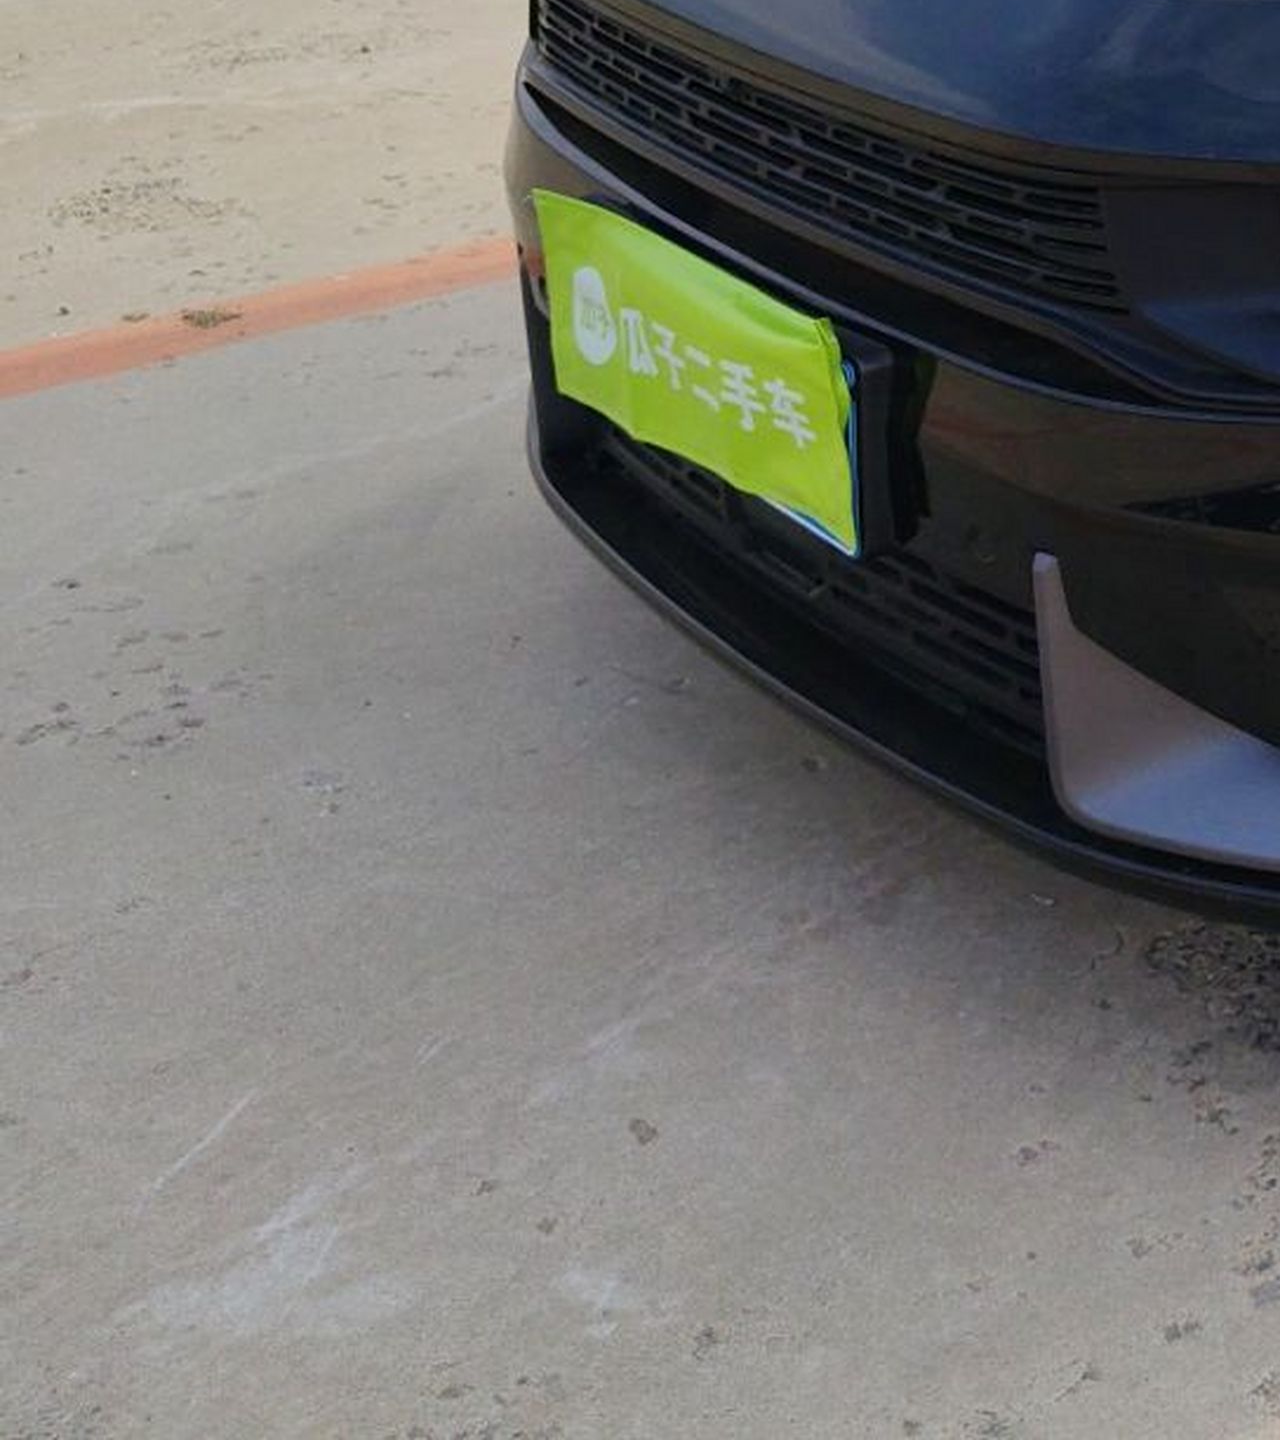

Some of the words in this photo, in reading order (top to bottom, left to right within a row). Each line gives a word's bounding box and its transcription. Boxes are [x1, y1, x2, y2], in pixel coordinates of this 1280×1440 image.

[622, 308, 816, 448] 瓜子二手车
